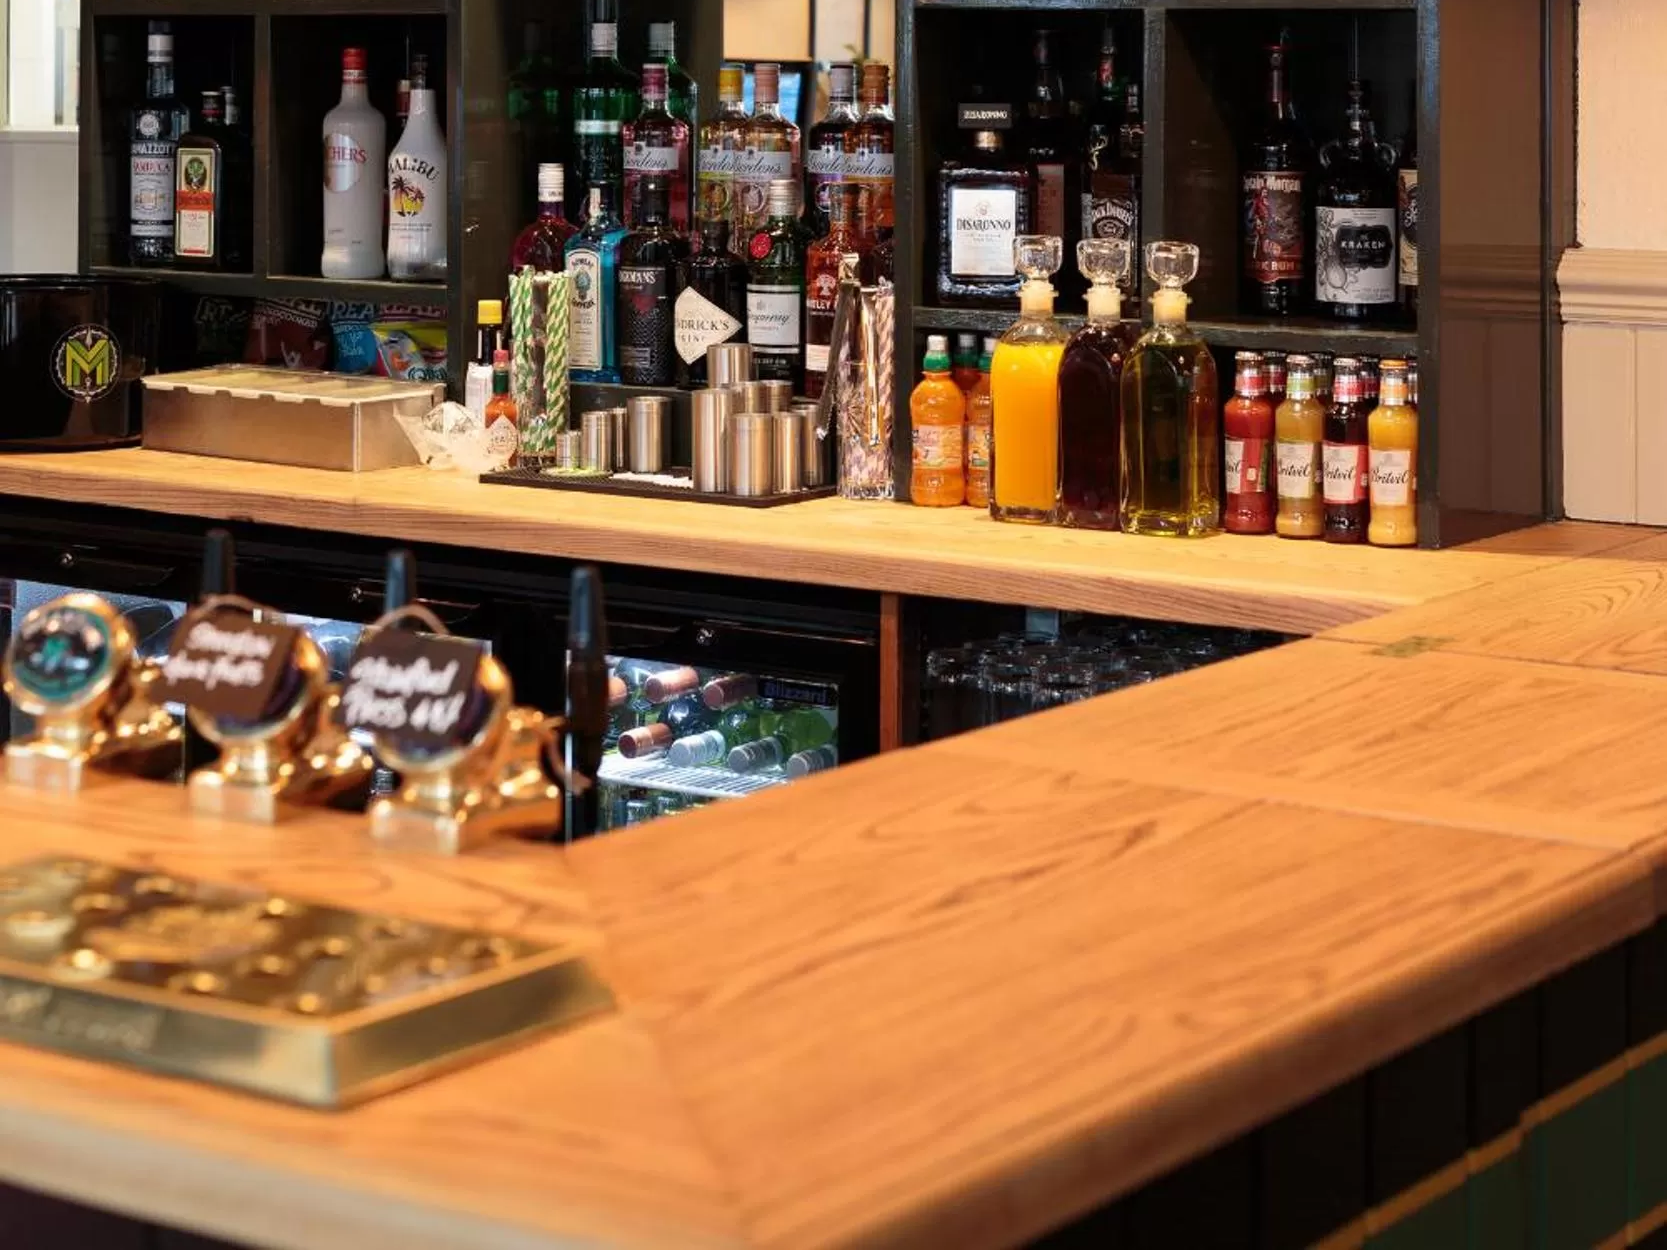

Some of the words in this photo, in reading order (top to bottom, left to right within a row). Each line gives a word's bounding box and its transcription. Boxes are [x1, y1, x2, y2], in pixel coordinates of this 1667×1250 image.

[956, 218, 1011, 233] DISARONNO
[1340, 240, 1386, 249] KRAKEN
[677, 319, 730, 331] DRICK'S
